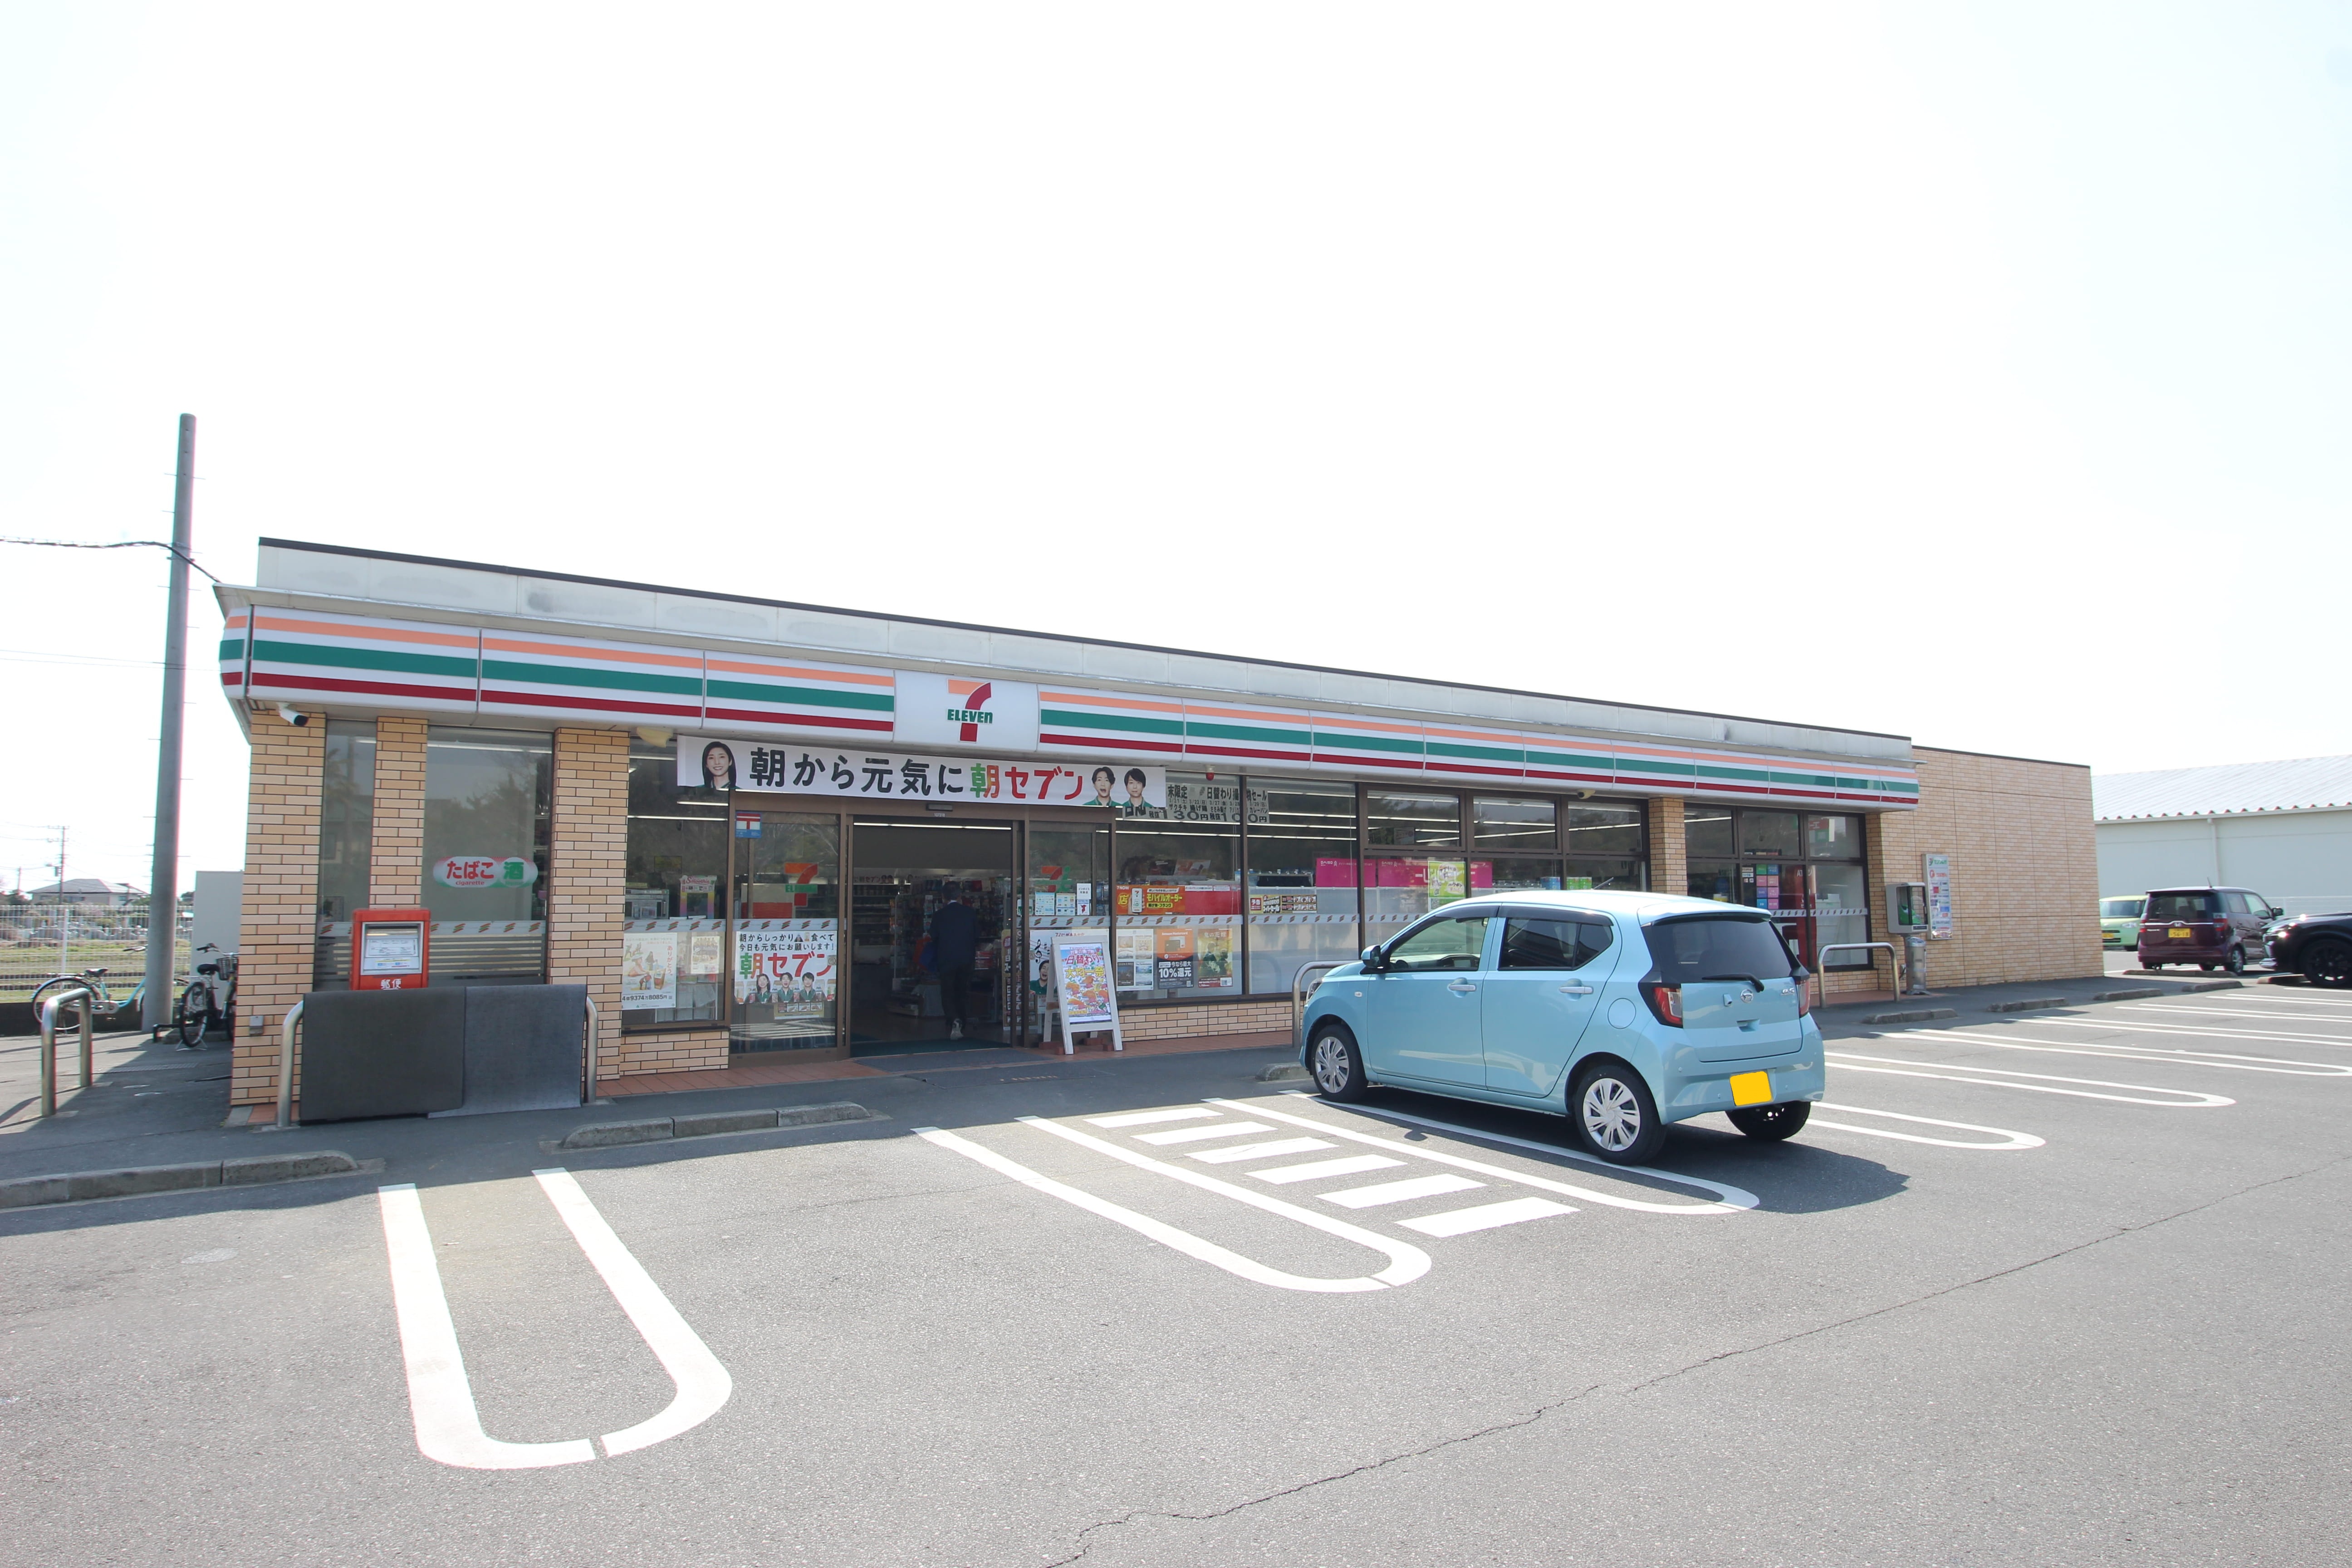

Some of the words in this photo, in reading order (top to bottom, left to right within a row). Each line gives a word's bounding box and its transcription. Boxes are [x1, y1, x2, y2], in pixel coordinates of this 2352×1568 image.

[750, 747, 1083, 800] 朝から元気に朝セブン
[446, 860, 494, 879] たばこ
[503, 861, 524, 880] 酒
[1147, 893, 1182, 902] モバイルオーダー
[740, 933, 794, 942] 朝からしっかり
[811, 933, 834, 941] 食べて
[740, 951, 832, 979] 朝セブン
[1066, 954, 1100, 965] 日替わり
[1064, 966, 1105, 978] 大均一祭
[381, 979, 402, 989] 郵便
